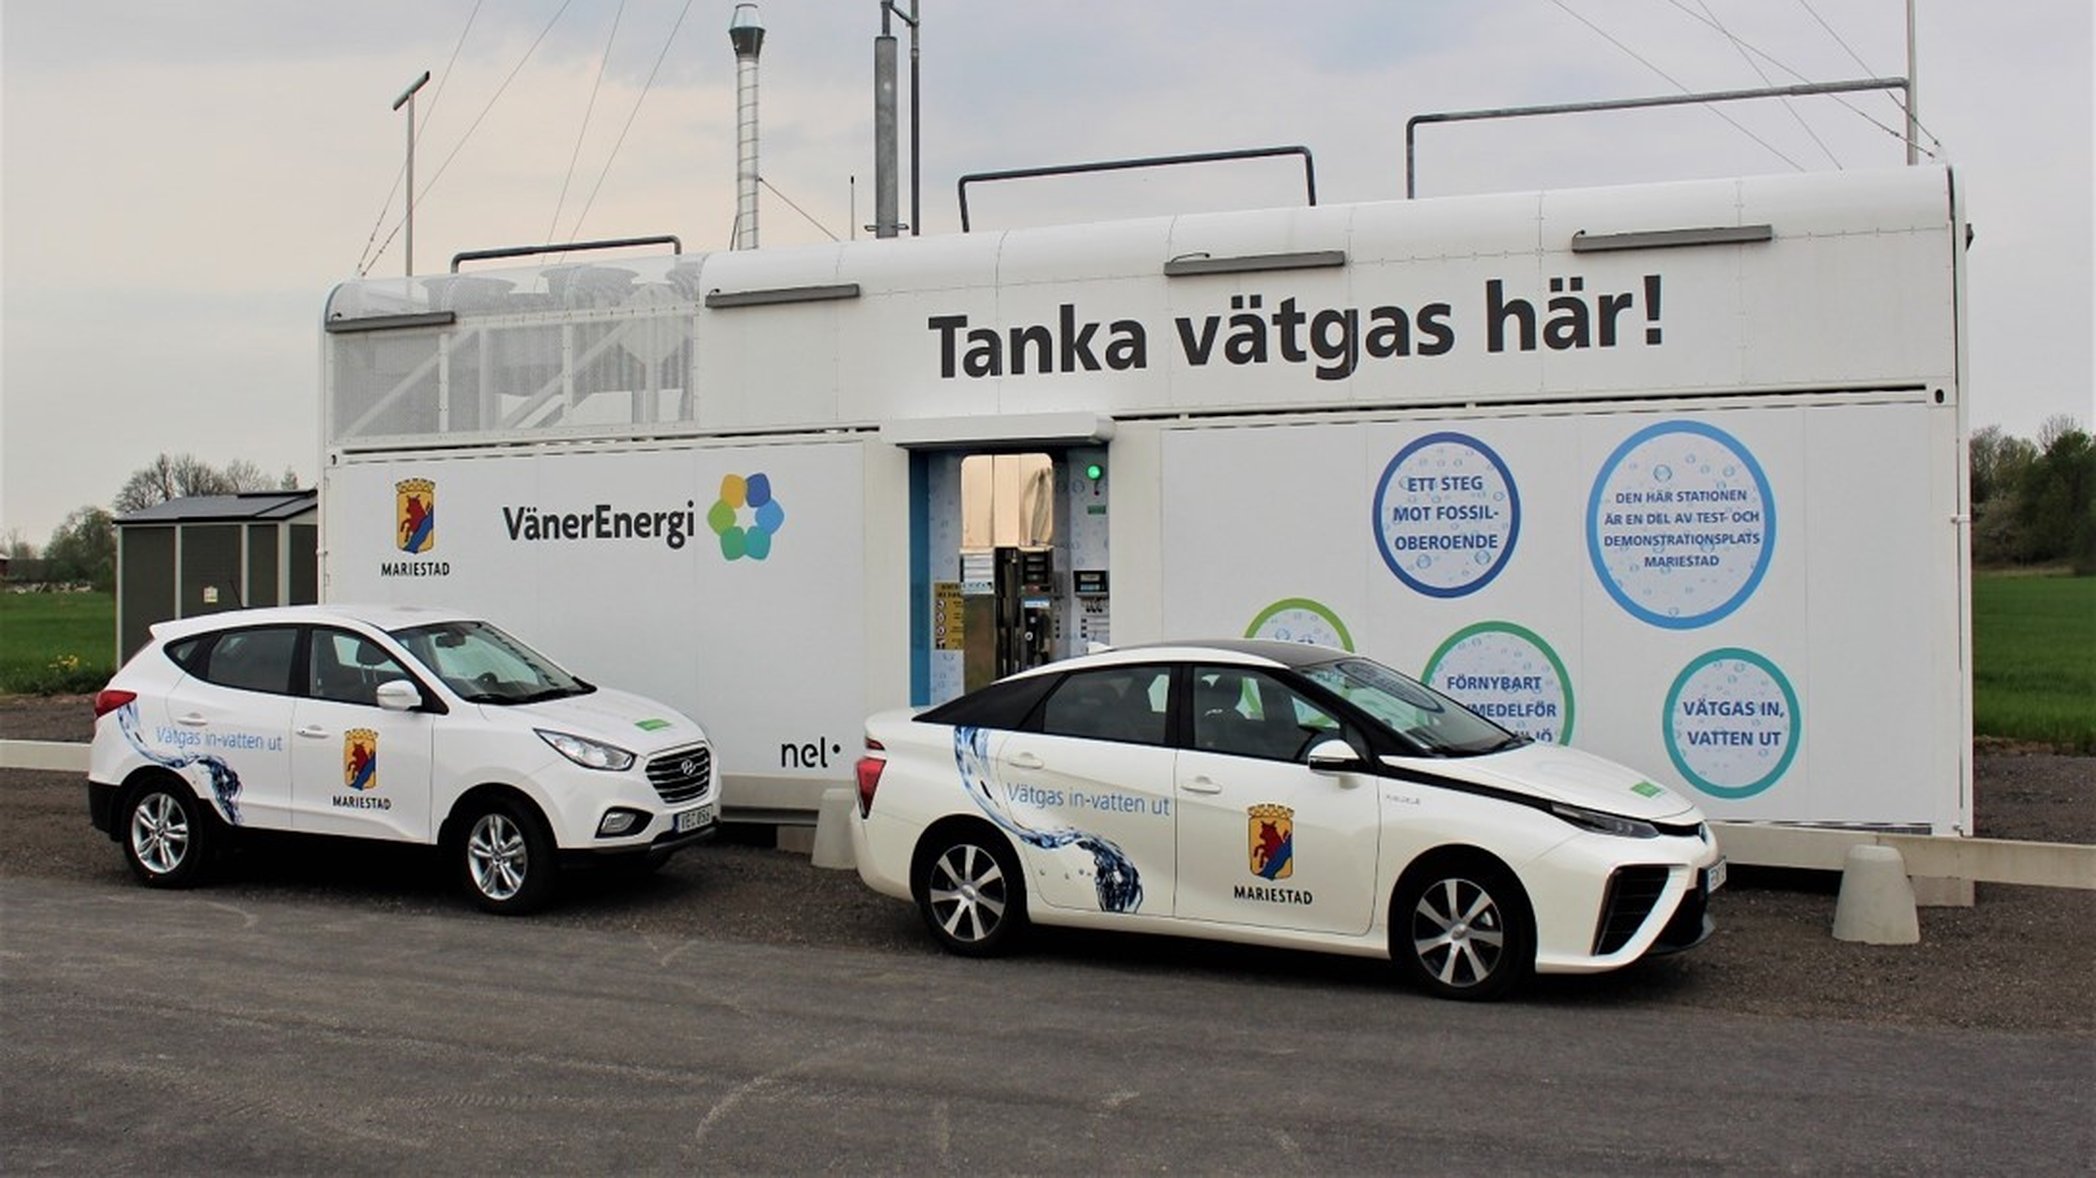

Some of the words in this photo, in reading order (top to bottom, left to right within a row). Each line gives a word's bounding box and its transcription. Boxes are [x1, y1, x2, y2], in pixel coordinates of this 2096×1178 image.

[928, 304, 1147, 378] Tanka
[1174, 294, 1455, 380] vätgas
[1485, 275, 1662, 353] här!
[1407, 477, 1436, 492] ETT
[1441, 475, 1483, 491] STEG
[1616, 492, 1642, 504] DEN
[1646, 489, 1673, 502] HÄR
[1677, 489, 1747, 502] STATIONEN
[1393, 507, 1431, 521] MOT
[1436, 505, 1499, 520] FOSSIL-
[1604, 512, 1622, 525] ÄR
[1626, 514, 1643, 525] EN
[1646, 513, 1670, 524] DEL
[1674, 512, 1692, 524] AV
[1697, 512, 1728, 523] TEST-
[1732, 511, 1760, 523] OCH
[503, 501, 694, 550] VänerEnergi
[1395, 534, 1498, 550] OBEROENDE
[1604, 533, 1761, 547] DEMONSTRATIONSPLATS
[1644, 555, 1720, 567] MARIESTAD
[381, 562, 450, 577] MARIESTAD
[1447, 675, 1542, 690] FÖRNYBART
[1468, 701, 1556, 718] MEDELFÖR
[1683, 698, 1755, 717] VÄTGAS
[1761, 701, 1785, 718] IN,
[268, 736, 283, 752] ut
[1687, 731, 1754, 746] VATTEN
[1759, 731, 1782, 746] UT
[332, 795, 392, 810] MARIESTAD
[1006, 782, 1065, 810] Vätgas
[1069, 787, 1146, 814] in-vatten
[1151, 797, 1171, 816] ut
[1234, 885, 1313, 905] MARIESTAD
